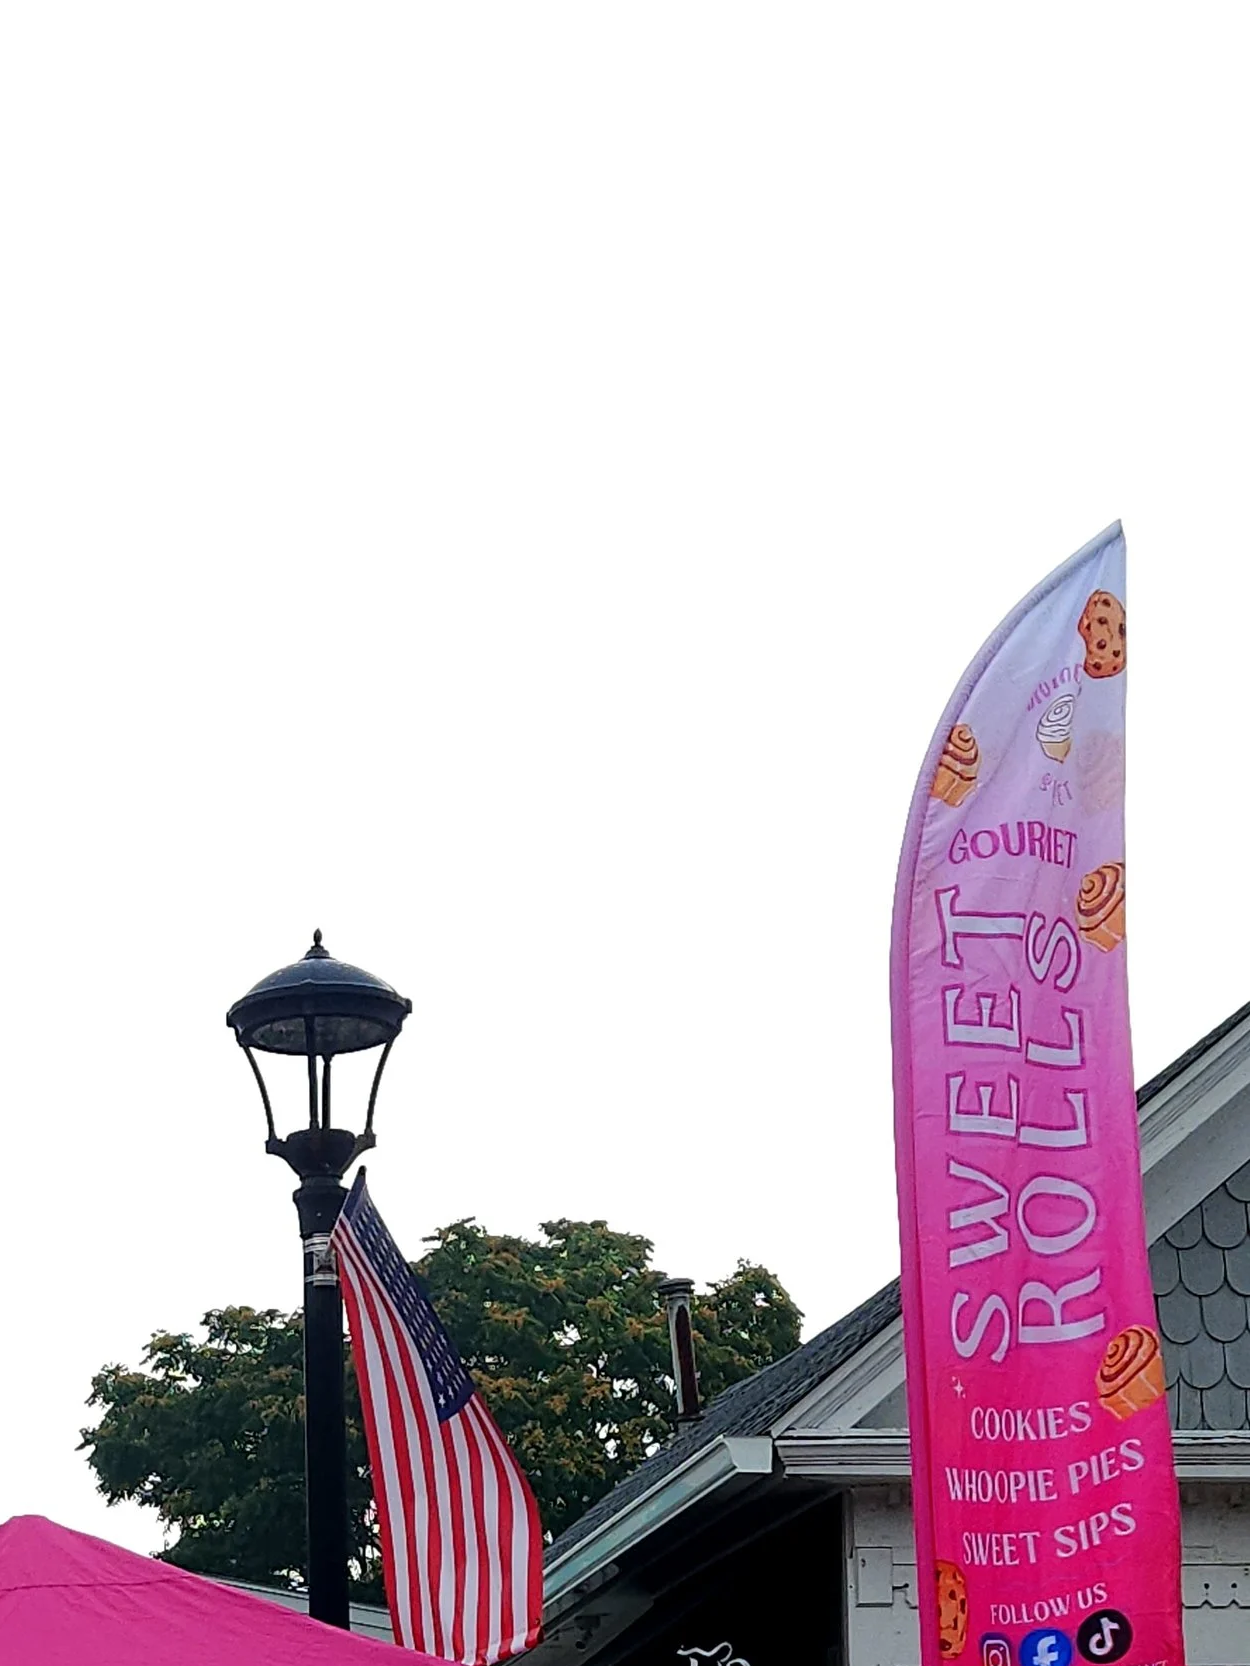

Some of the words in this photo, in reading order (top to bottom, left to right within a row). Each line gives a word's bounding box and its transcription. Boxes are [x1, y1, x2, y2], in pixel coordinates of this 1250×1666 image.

[936, 885, 1026, 1363] SWEET
[1018, 911, 1105, 1348] ROLLS
[970, 1401, 1092, 1441] COOKIES
[945, 1467, 1058, 1503] WHOOPIE
[1068, 1438, 1145, 1495] PIES
[963, 1531, 1041, 1566] SWEET
[1053, 1503, 1137, 1558] SIPS
[990, 1594, 1071, 1625] FOLLOW
[1077, 1582, 1109, 1609] US
